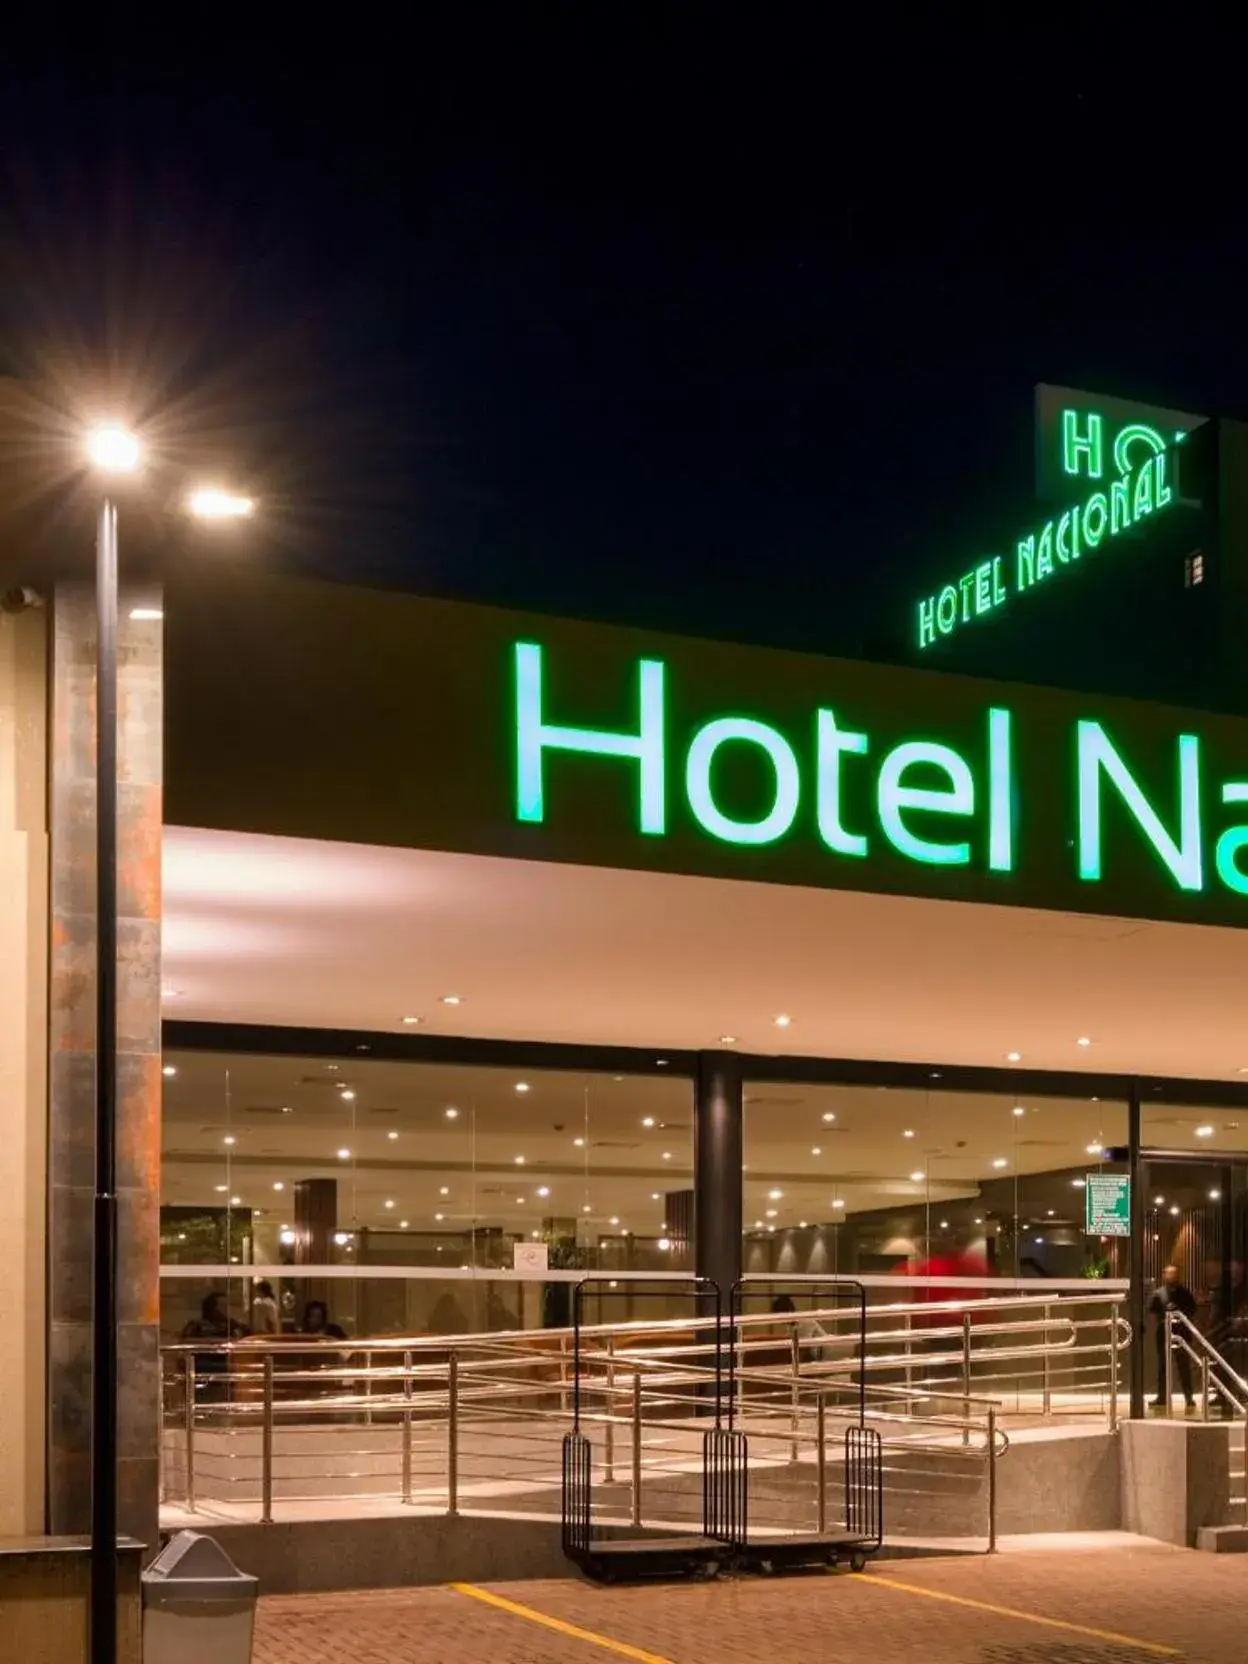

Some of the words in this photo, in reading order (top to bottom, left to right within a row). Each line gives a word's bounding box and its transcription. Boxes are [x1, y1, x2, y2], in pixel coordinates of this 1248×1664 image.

[1062, 409, 1186, 480] HO
[918, 556, 1006, 648] HOTEL
[1017, 453, 1171, 592] NACIONAL
[514, 641, 1013, 872] Hotel
